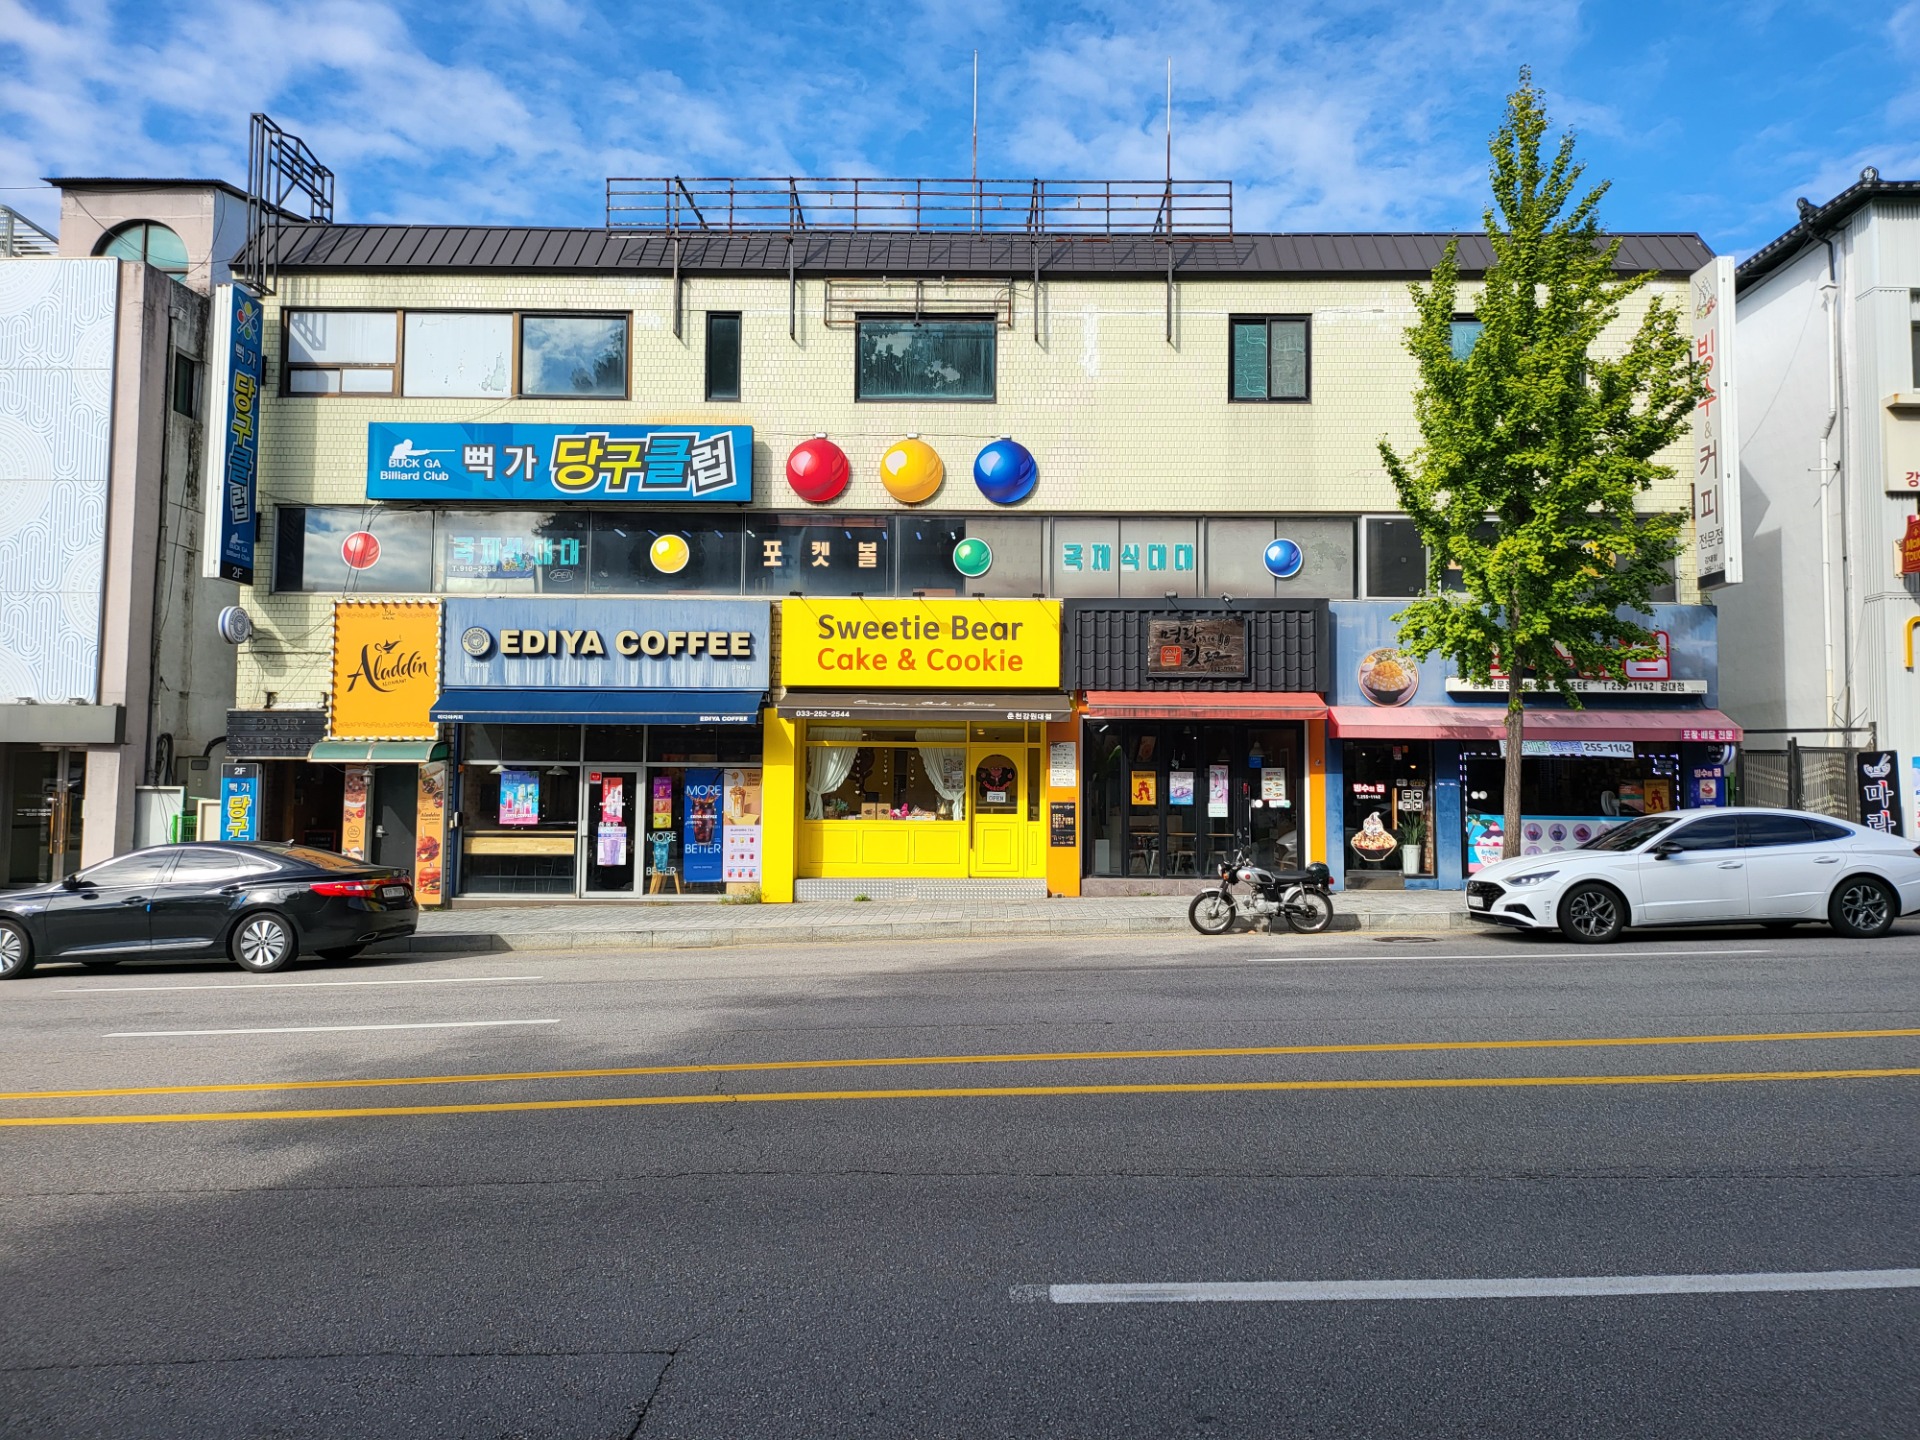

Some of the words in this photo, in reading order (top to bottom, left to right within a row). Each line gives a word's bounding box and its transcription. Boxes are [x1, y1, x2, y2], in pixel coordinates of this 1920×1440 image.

[388, 458, 420, 469] BUCK
[424, 459, 441, 469] GA
[551, 432, 736, 496] 당구클럽
[380, 471, 420, 481] Billiard
[423, 471, 449, 481] Club
[1063, 543, 1194, 572] 국제식대대
[232, 566, 243, 579] 2F
[818, 614, 940, 640] Sweetie
[951, 614, 1023, 641] Bear
[500, 629, 605, 655] EDIYA
[615, 630, 751, 656] COFFEE
[817, 647, 888, 671] Cake
[898, 647, 917, 671] &
[927, 647, 1024, 672] Cookie
[346, 643, 430, 693] Aladdin
[796, 710, 850, 718] 033-252-2544
[1584, 742, 1632, 753] 255-1142
[234, 767, 246, 775] 2F
[686, 785, 722, 796] MORE
[646, 832, 677, 842] MORE
[684, 843, 721, 854] BETTER
